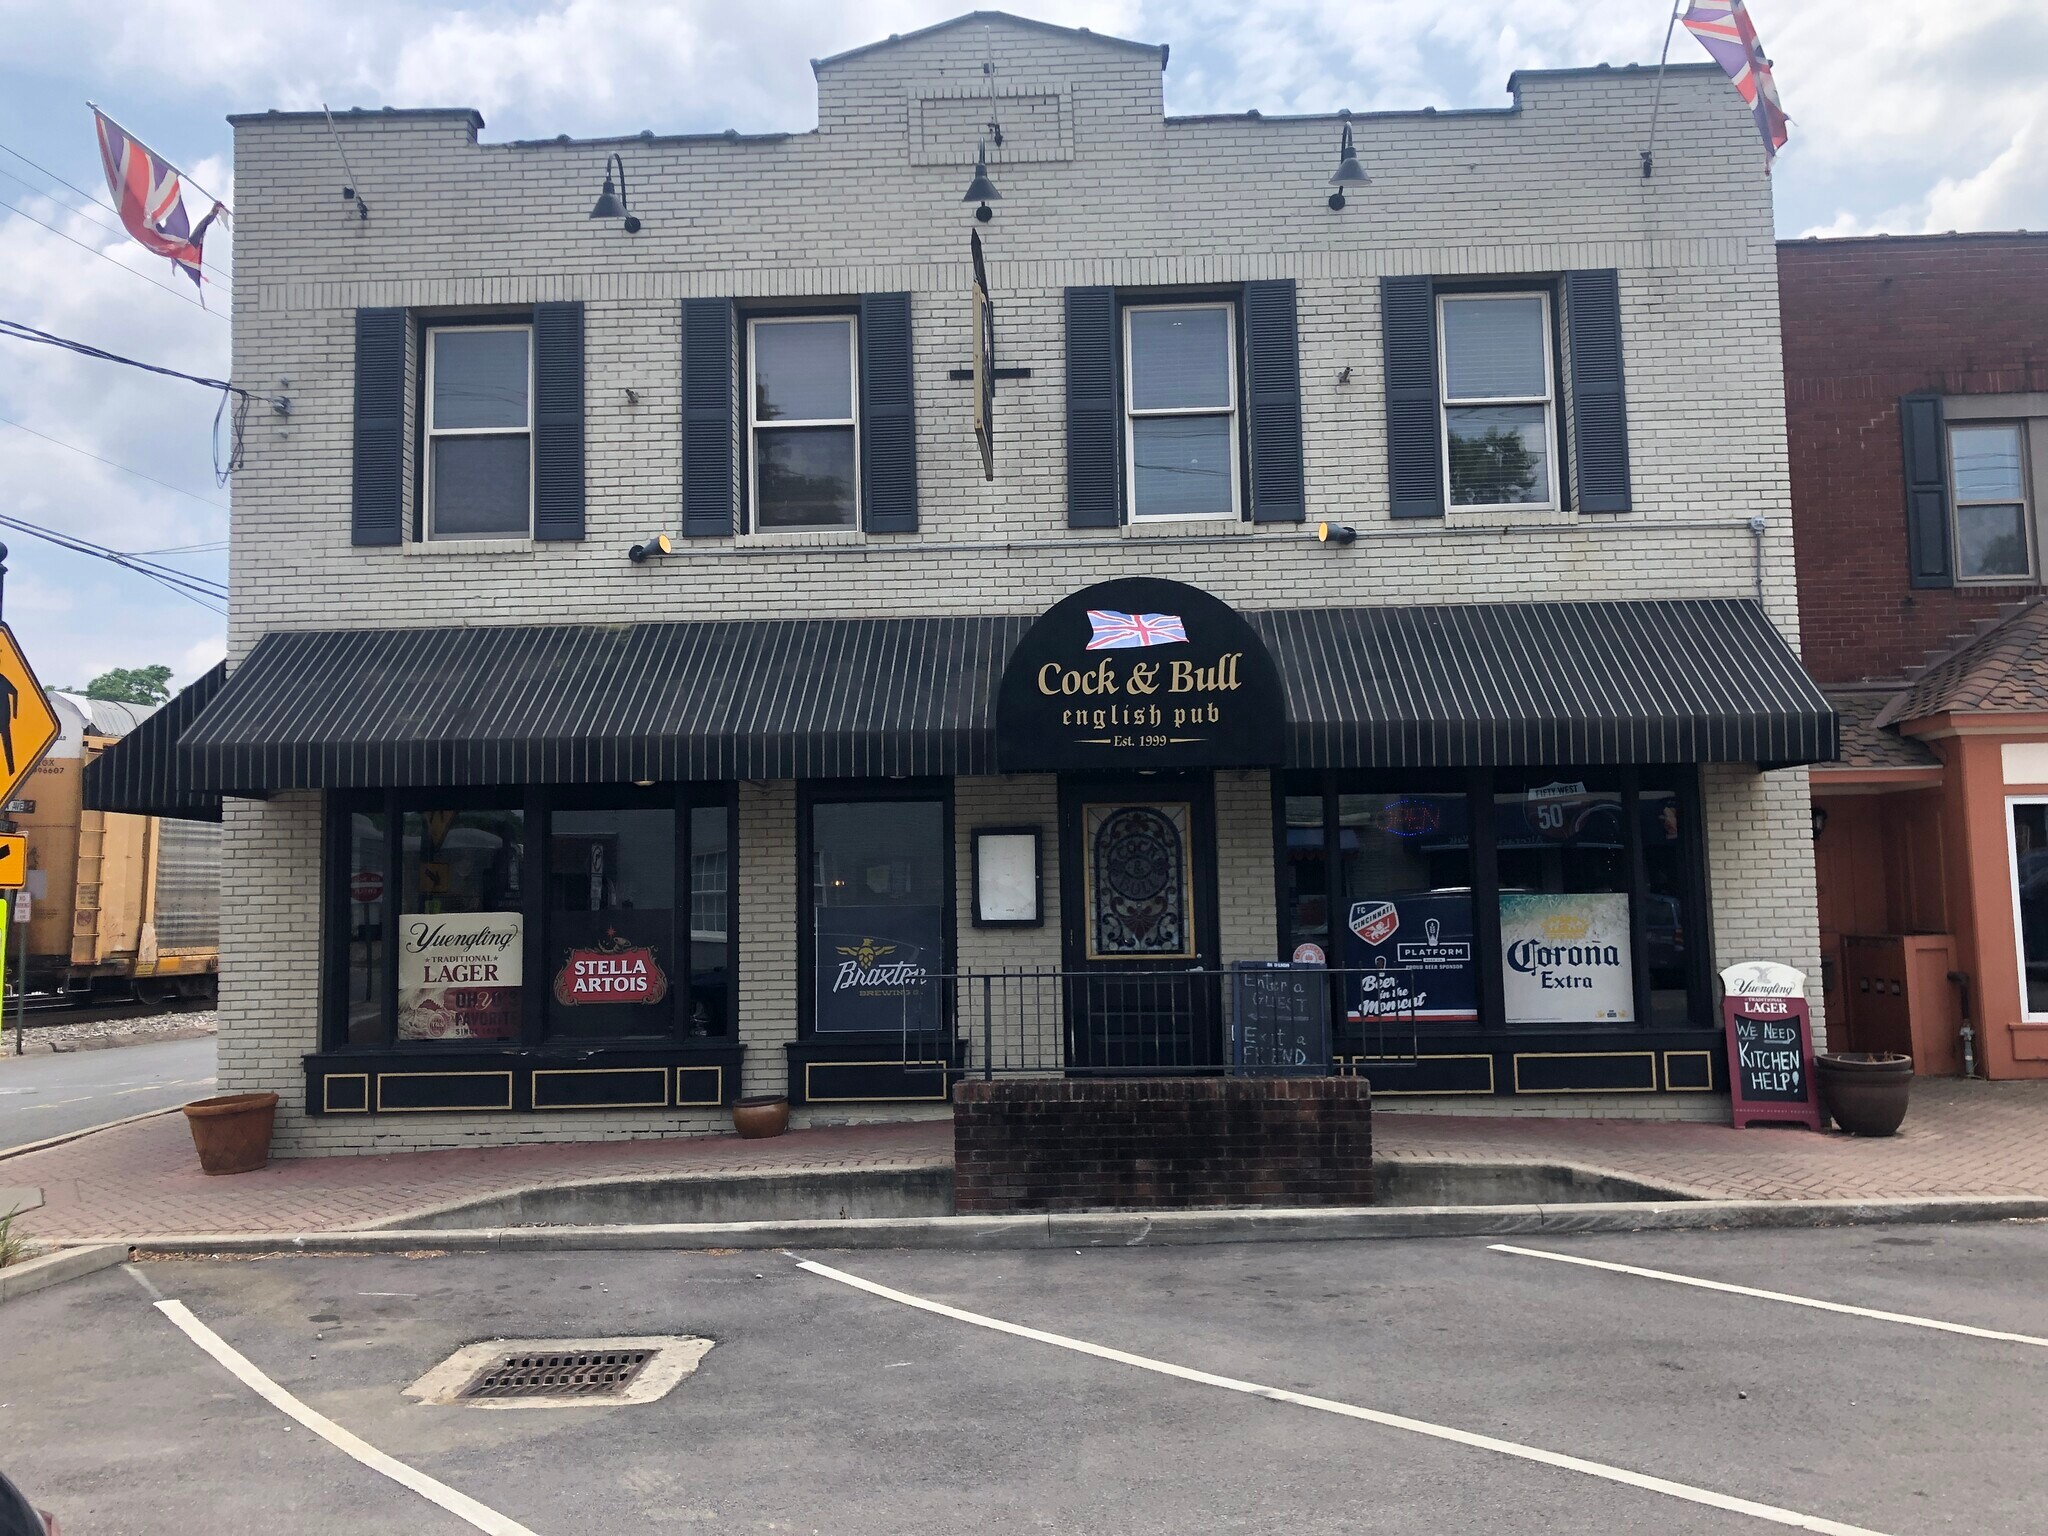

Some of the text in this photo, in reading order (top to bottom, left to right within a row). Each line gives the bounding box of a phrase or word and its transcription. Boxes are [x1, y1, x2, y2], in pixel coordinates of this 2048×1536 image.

[1038, 652, 1243, 696] Cock & Bull
[1062, 703, 1220, 730] english pub
[1113, 735, 1167, 747] Est. 1999
[1535, 784, 1579, 798] FIFTY WEST
[1376, 807, 1441, 832] OPEN
[1537, 804, 1563, 829] 50
[1353, 904, 1393, 930] CINCINNATI
[1356, 906, 1366, 914] FC
[406, 922, 519, 953] Yuengling
[431, 955, 493, 963] TRADITIONAL
[1404, 948, 1463, 956] PLATFORM
[423, 964, 499, 984] LAGER
[574, 960, 647, 976] STELLA
[832, 960, 928, 993] Braxton
[573, 976, 648, 993] ARTOIS
[1362, 975, 1397, 992] Beer
[1541, 970, 1593, 989] Extra
[1733, 978, 1795, 996] Yuengling
[1358, 992, 1427, 1015] Moment
[1744, 1002, 1788, 1014] LAGER
[1763, 1022, 1796, 1042] NEED
[1243, 1046, 1307, 1066] FREND
[1738, 1041, 1800, 1071] KITCHEN
[1751, 1071, 1800, 1094] HELP!
